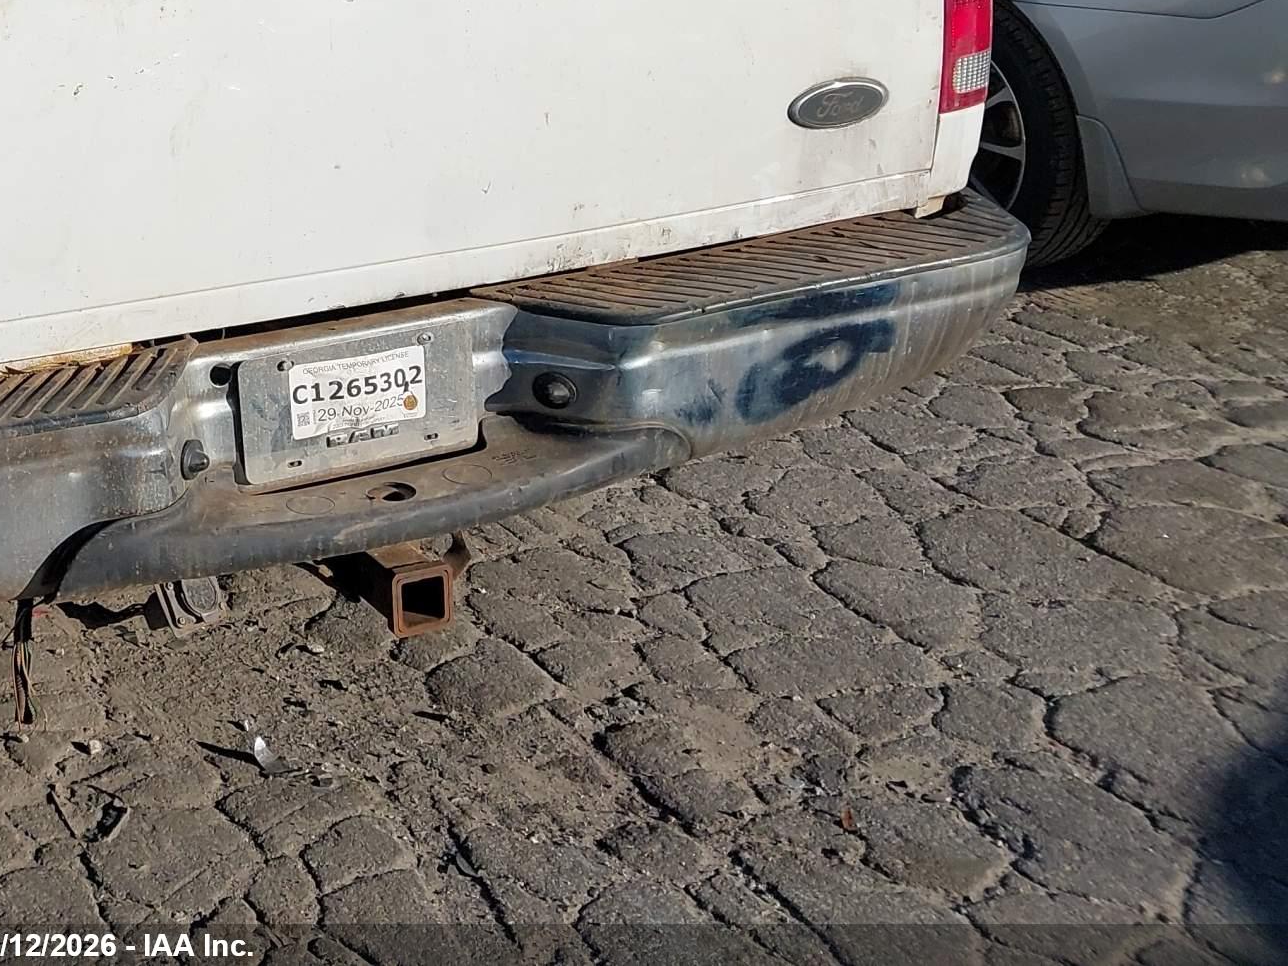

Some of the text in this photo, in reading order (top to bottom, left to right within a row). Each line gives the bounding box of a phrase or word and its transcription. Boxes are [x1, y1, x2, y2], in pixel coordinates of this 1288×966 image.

[816, 91, 865, 118] Ford
[303, 351, 409, 375] GEORGIA TEMPORARY LICENSE
[292, 365, 423, 405] C1265302
